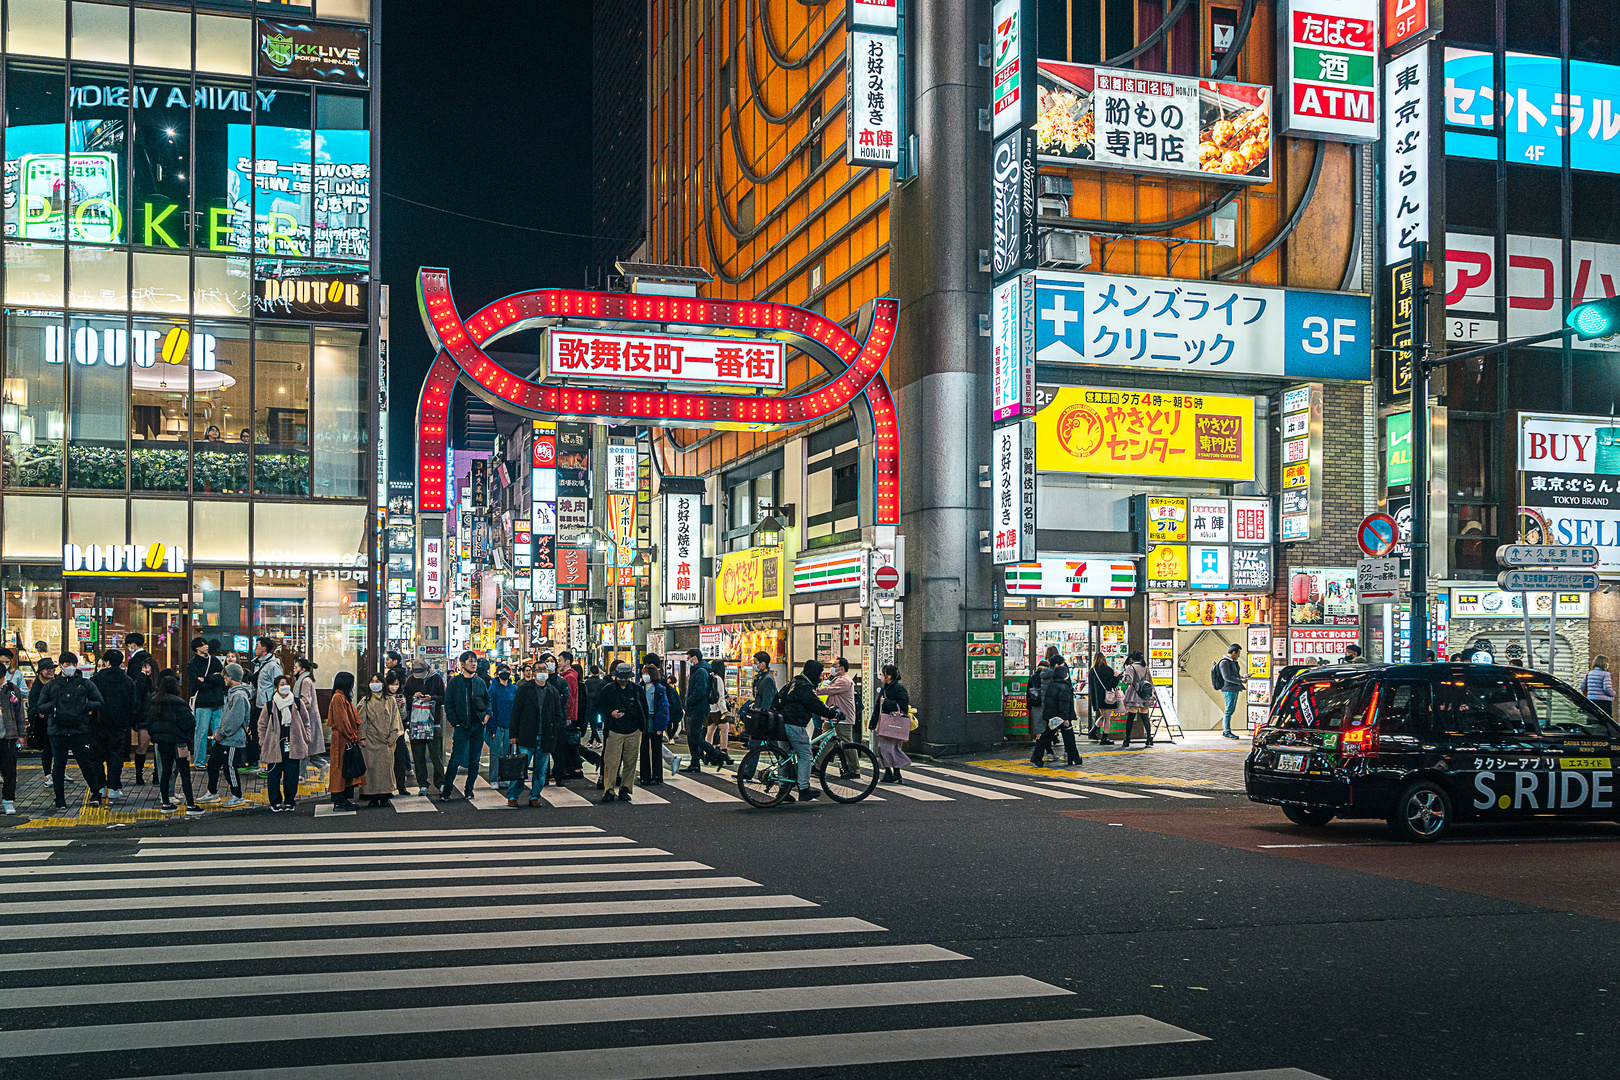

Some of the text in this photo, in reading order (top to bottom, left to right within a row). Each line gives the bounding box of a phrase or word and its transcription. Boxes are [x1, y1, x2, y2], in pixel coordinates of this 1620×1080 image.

[1302, 15, 1365, 47] たばこ
[1396, 14, 1416, 37] 3F
[294, 55, 360, 67] POKER SHINJUKU
[1318, 52, 1350, 82] 酒
[867, 40, 885, 126] お好み焼き
[1098, 75, 1174, 97] 歌舞伎町名物
[998, 92, 1015, 112] ATM
[1105, 97, 1184, 130] 粉もの
[1299, 87, 1369, 120] ATM
[859, 128, 893, 147] 本陣
[1105, 129, 1185, 163] 専門店
[860, 147, 891, 160] HONJIN
[1524, 145, 1545, 161] 4F
[1022, 158, 1035, 218] Sparkle
[994, 142, 1020, 274] Sparkle
[19, 194, 303, 257] POKER
[1023, 219, 1035, 260] スパークル
[265, 278, 359, 306] DOUTOR
[1093, 283, 1267, 326] メンズライフ
[1023, 288, 1033, 367] ファイトフィット
[1301, 316, 1357, 356] 3F
[1454, 321, 1480, 338] 3F
[45, 325, 217, 371] DOUTOR
[557, 337, 775, 380] 歌舞伎町一番街
[1001, 306, 1010, 404] ファイトフィット
[1093, 325, 1236, 366] クリニック
[1036, 389, 1053, 406] 2F
[1086, 391, 1119, 404] 営業時間
[1104, 406, 1181, 436] やきとり
[1197, 417, 1240, 435] やきとり
[1106, 434, 1186, 463] センター
[1199, 435, 1238, 453] 専門店
[1528, 432, 1592, 462] BUY
[614, 454, 625, 490] 東南荘
[1001, 434, 1011, 526] お好み焼き
[1286, 466, 1306, 478] 麻雀
[1531, 475, 1620, 493] 東京ぶらん
[1023, 447, 1034, 536] 歌舞伎町名物
[1553, 495, 1609, 506] TOKYO BRAND
[620, 496, 631, 547] ハイボール
[677, 497, 691, 558] お好み焼き
[1157, 521, 1178, 532] ブル
[1194, 515, 1224, 530] 本陣
[996, 529, 1017, 549] 本陣
[1525, 549, 1579, 558] 大久保病院
[64, 542, 186, 573] DOUTOR
[427, 542, 438, 596] 劇場通り
[565, 550, 580, 583] ステップ
[1156, 562, 1178, 571] やきとり
[1233, 550, 1259, 560] BUZZ
[1234, 560, 1267, 570] STAND
[676, 561, 691, 591] 本陣
[671, 593, 697, 601] HONJIN
[1101, 645, 1117, 653] たばこ
[1294, 642, 1354, 653] 歌舞伎町名
[1474, 757, 1555, 770] タクシーアプリ
[1473, 771, 1613, 810] S.RIDE
